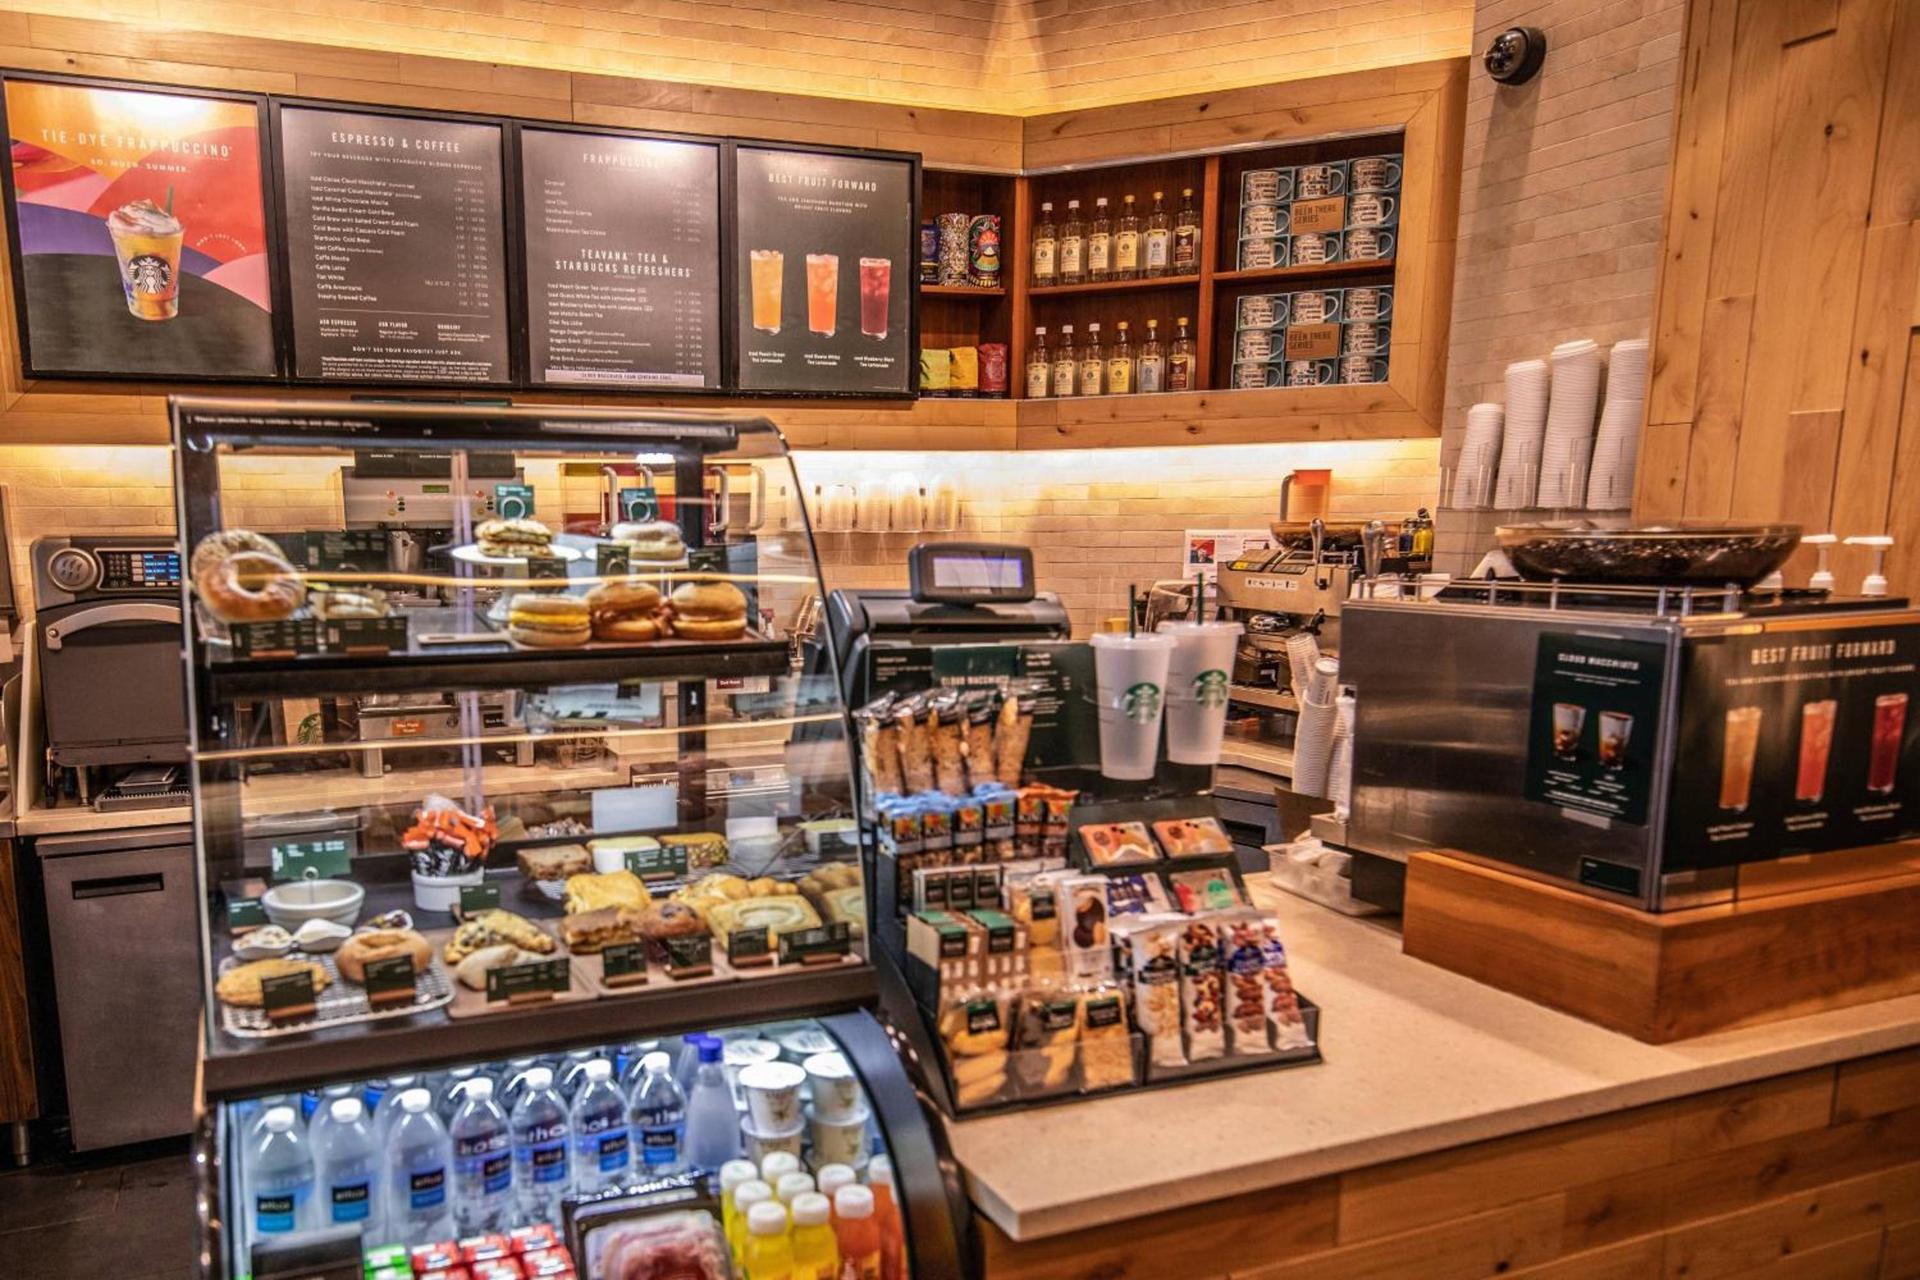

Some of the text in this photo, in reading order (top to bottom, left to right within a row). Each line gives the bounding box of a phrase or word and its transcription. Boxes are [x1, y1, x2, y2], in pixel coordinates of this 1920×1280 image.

[332, 132, 461, 153] ESPRESSO & COFFEE
[768, 173, 877, 192] BEST FRUIT FORWARD
[555, 260, 618, 273] STARBUCKS
[637, 252, 657, 263] TEA
[662, 254, 668, 264] &
[1557, 653, 1640, 670] CLOUD MACCHIATO
[1751, 639, 1896, 666] BEST FRUIT FORWARD
